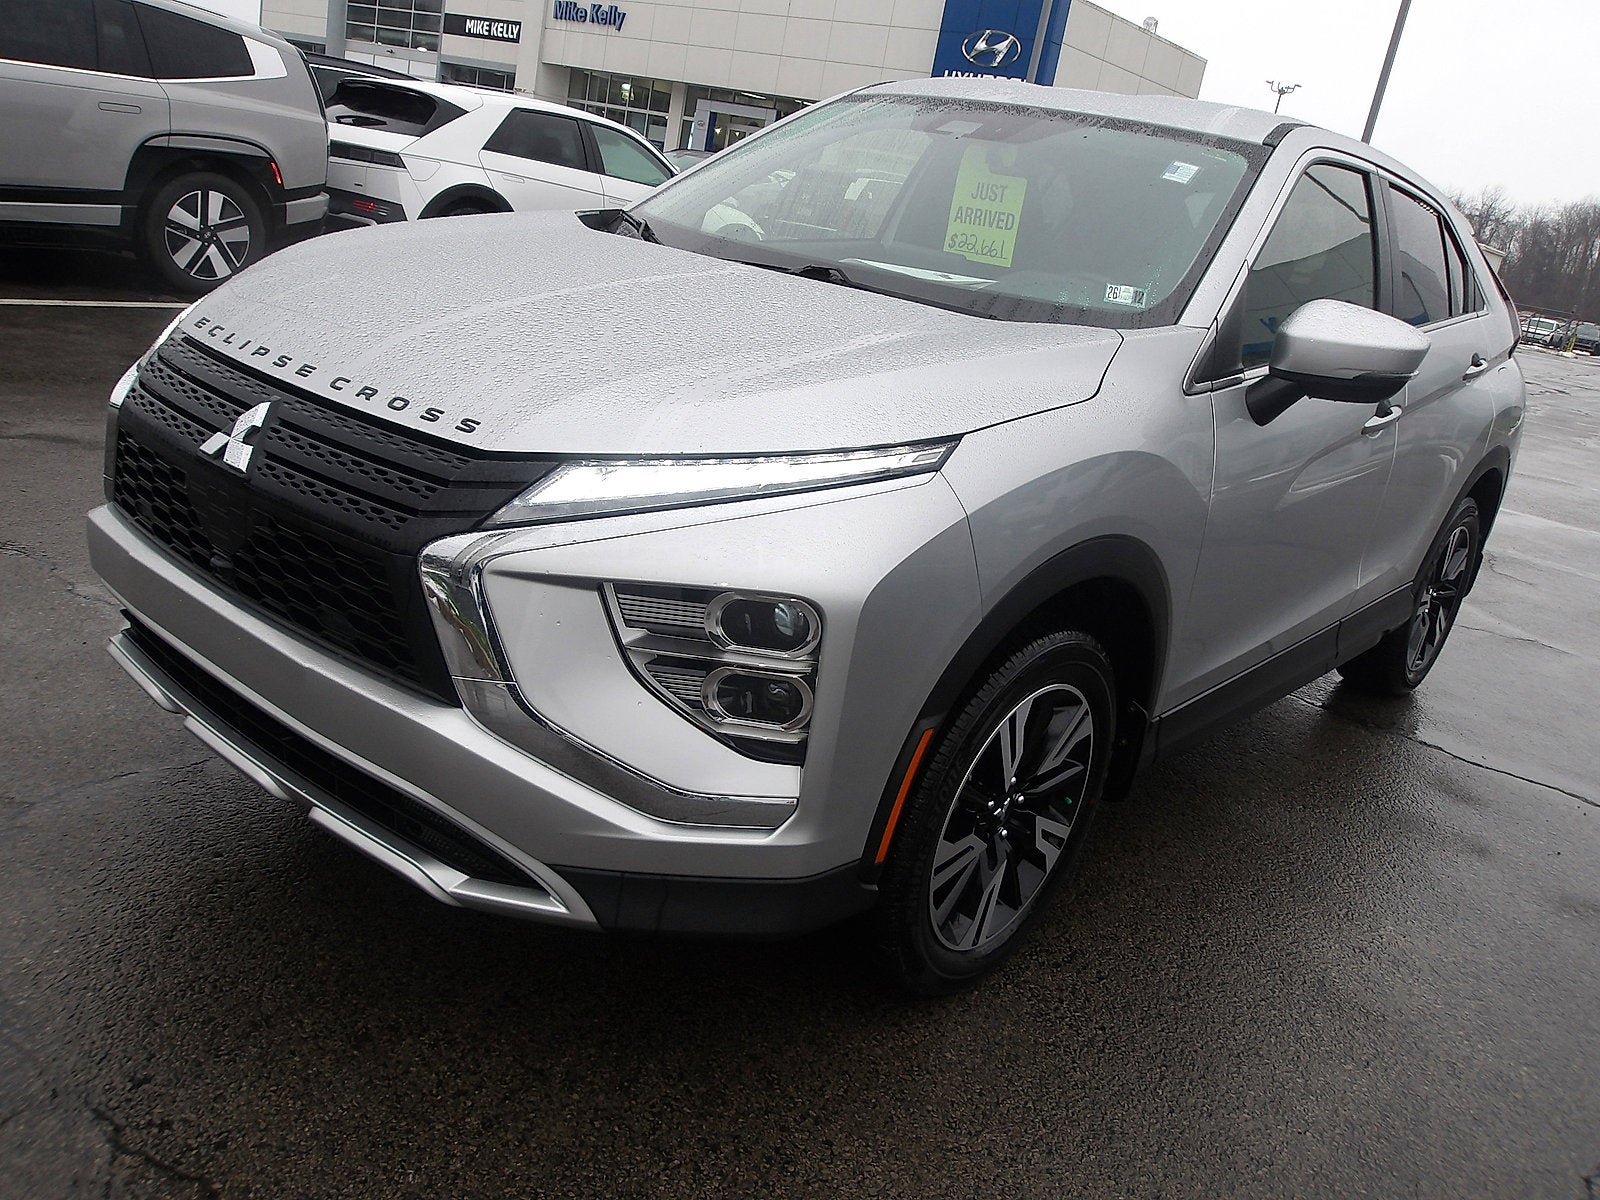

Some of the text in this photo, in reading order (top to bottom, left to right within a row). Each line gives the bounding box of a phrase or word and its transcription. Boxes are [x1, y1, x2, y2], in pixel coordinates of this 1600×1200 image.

[465, 18, 520, 40] MIKE KELLY
[553, 0, 626, 32] Mike Kelly
[971, 182, 1008, 203] JUST
[953, 205, 1016, 231] ARRIVED
[948, 232, 1006, 259] $22,661
[1107, 285, 1119, 300] 26
[193, 316, 482, 434] ECLIPSE CROSS
